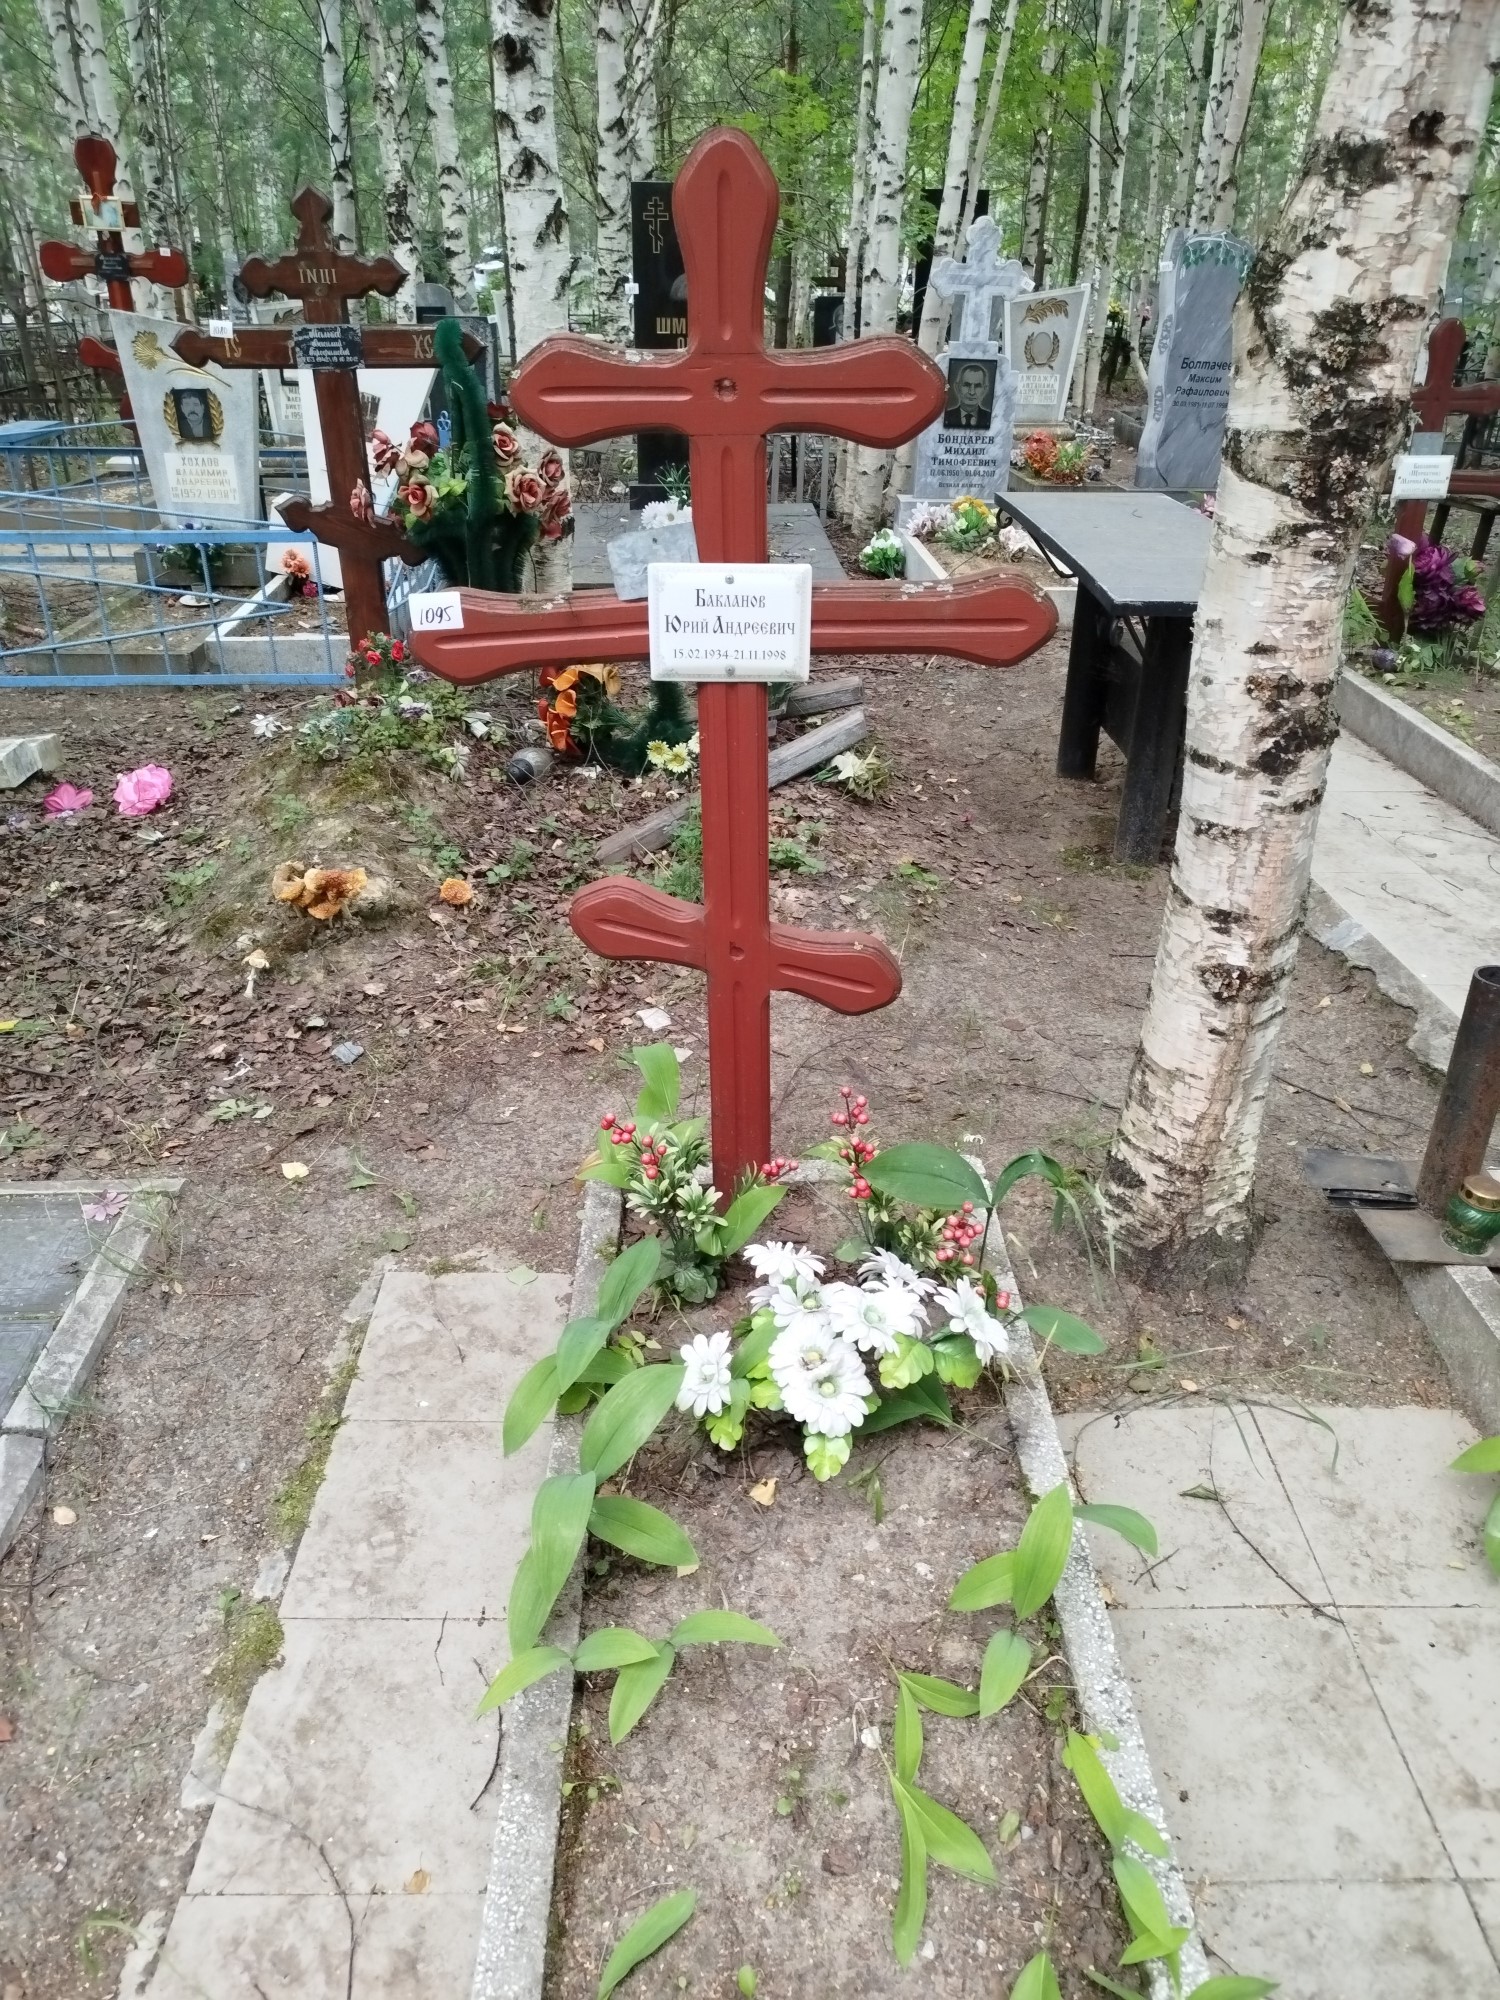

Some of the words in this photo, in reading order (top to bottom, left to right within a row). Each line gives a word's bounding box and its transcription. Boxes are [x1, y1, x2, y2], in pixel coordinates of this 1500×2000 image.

[1187, 374, 1222, 384] Максим
[1175, 386, 1230, 397] Рафаилович
[181, 456, 220, 467] ХОХЛОВ
[176, 468, 228, 477] ВЛАДИМИР
[176, 477, 231, 487] АНДРЕЕВИЧ
[420, 606, 454, 625] 1095
